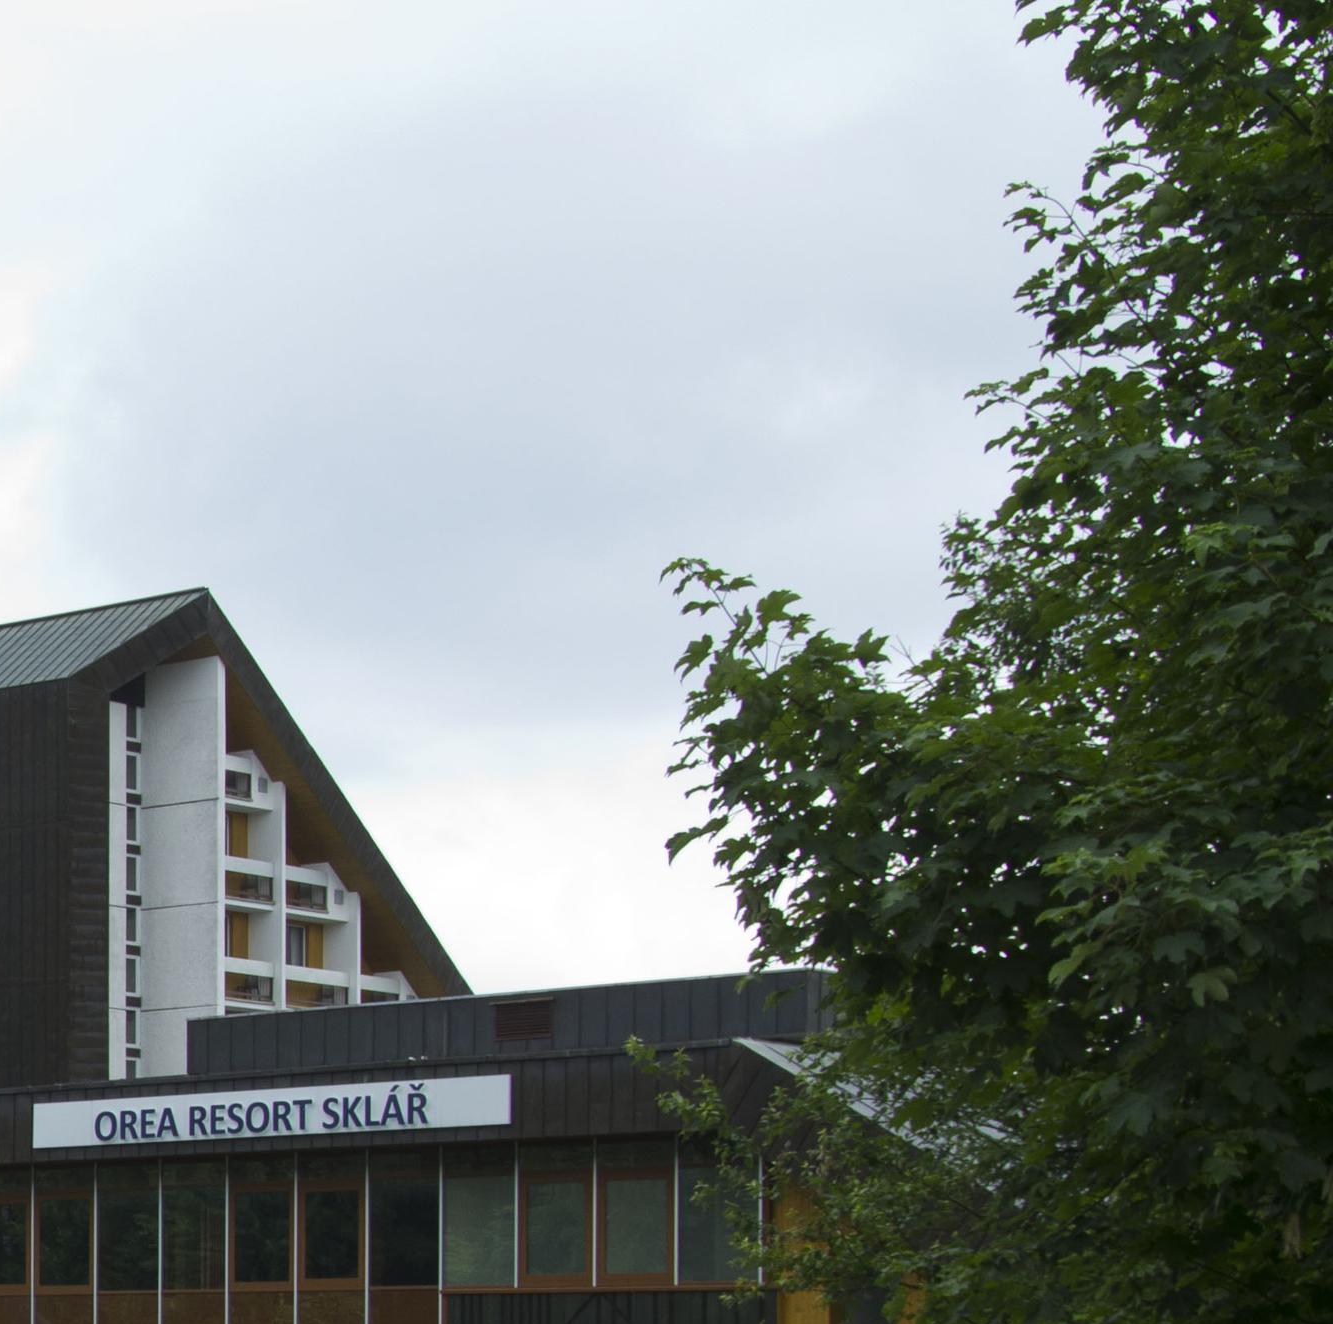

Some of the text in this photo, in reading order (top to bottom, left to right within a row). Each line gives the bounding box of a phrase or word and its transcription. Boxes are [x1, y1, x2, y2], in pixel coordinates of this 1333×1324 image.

[94, 1083, 429, 1141] OREA RESORT SKLÁŘ
